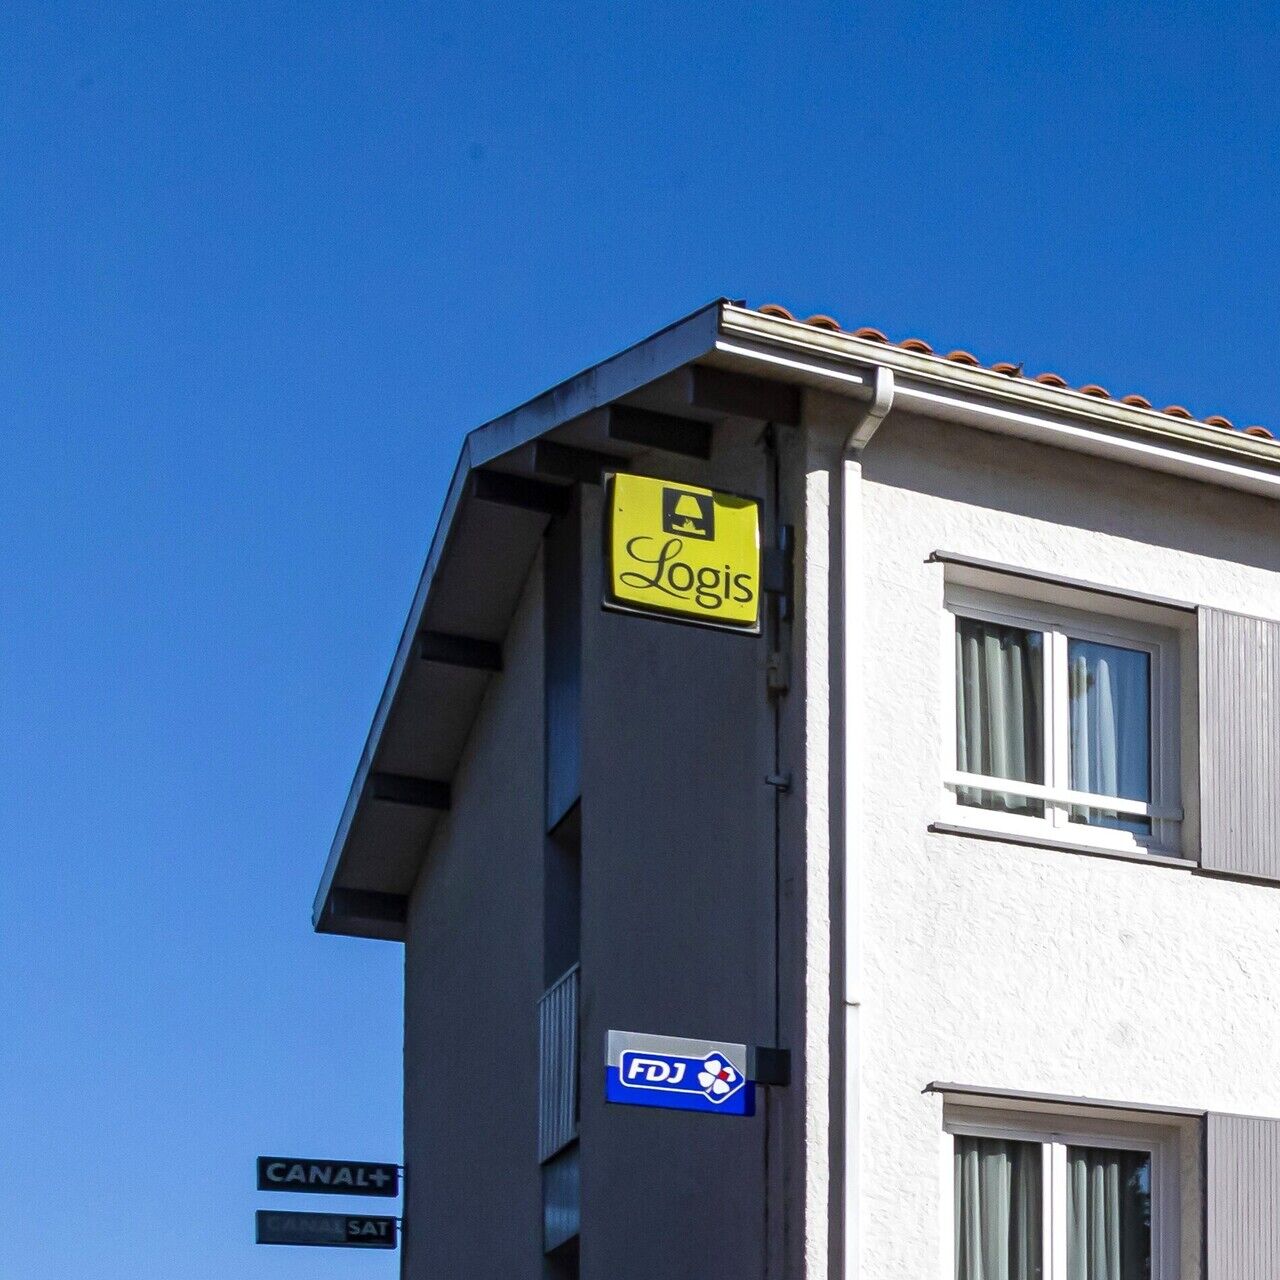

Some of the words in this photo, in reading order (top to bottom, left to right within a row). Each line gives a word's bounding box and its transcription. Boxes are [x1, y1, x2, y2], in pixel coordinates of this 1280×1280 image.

[619, 536, 753, 609] Logis
[627, 1058, 686, 1084] FDJ
[265, 1162, 391, 1188] CANAL+
